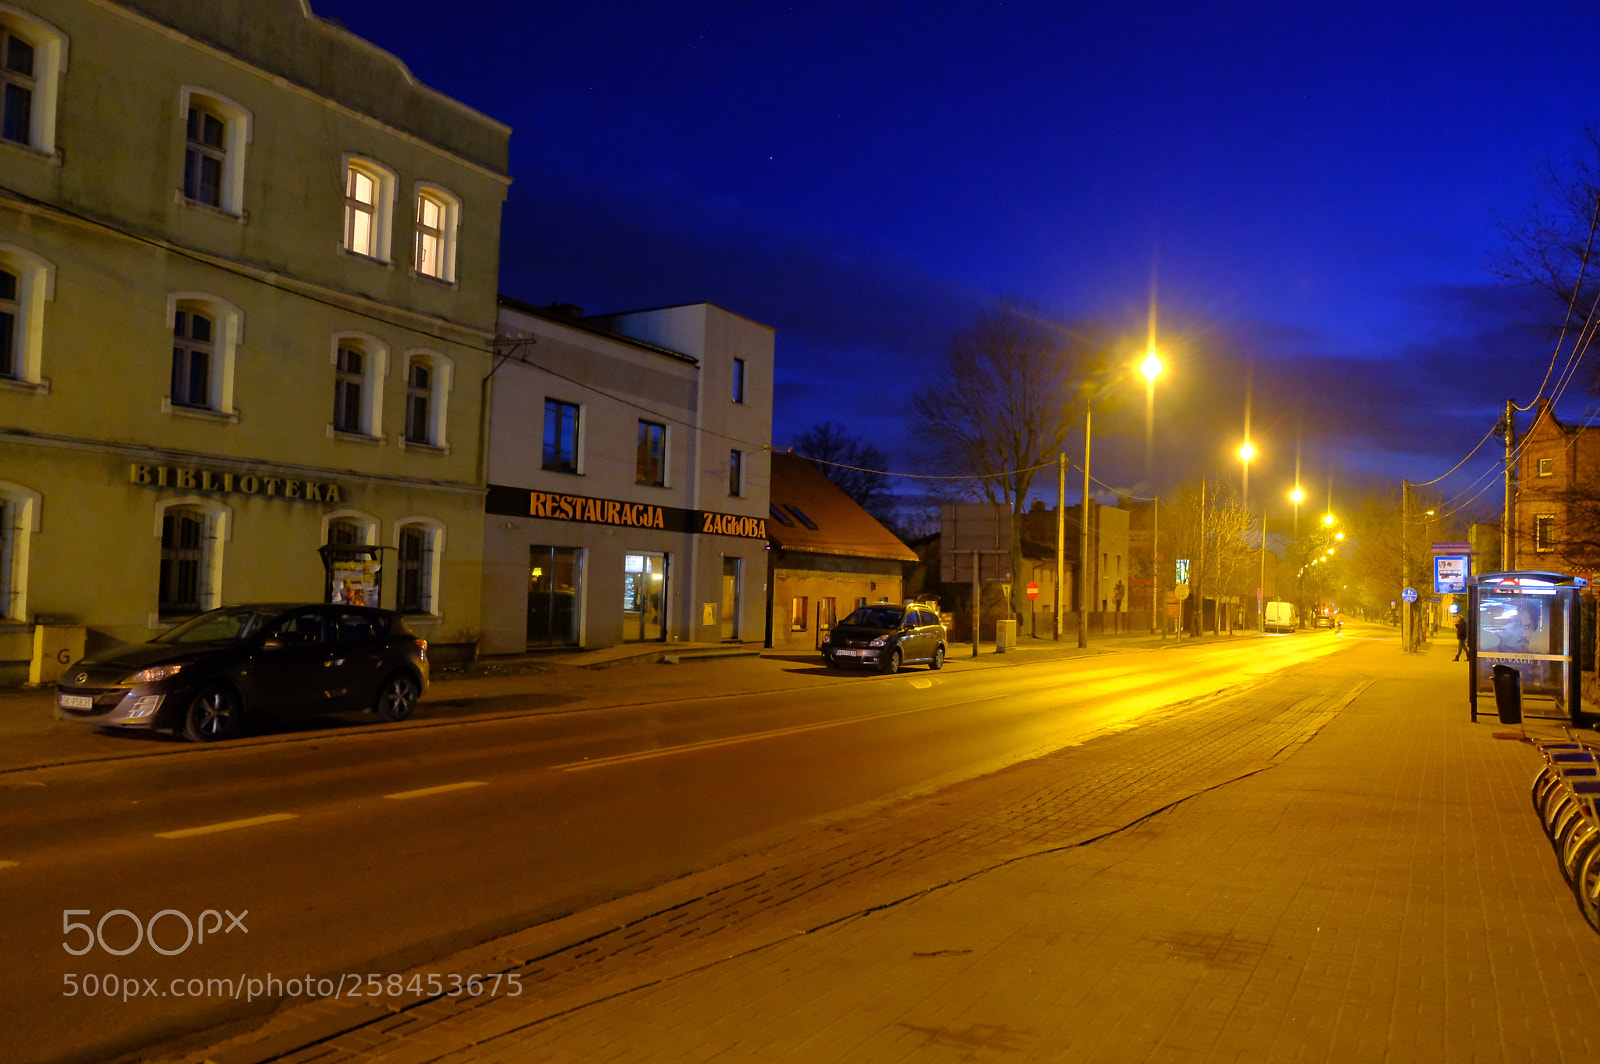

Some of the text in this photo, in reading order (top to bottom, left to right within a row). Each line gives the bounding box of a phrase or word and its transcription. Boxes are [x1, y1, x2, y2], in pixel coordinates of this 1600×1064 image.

[130, 463, 340, 502] BIBLIOTEKA
[530, 491, 664, 529] RESTAURACJA
[57, 648, 71, 665] G
